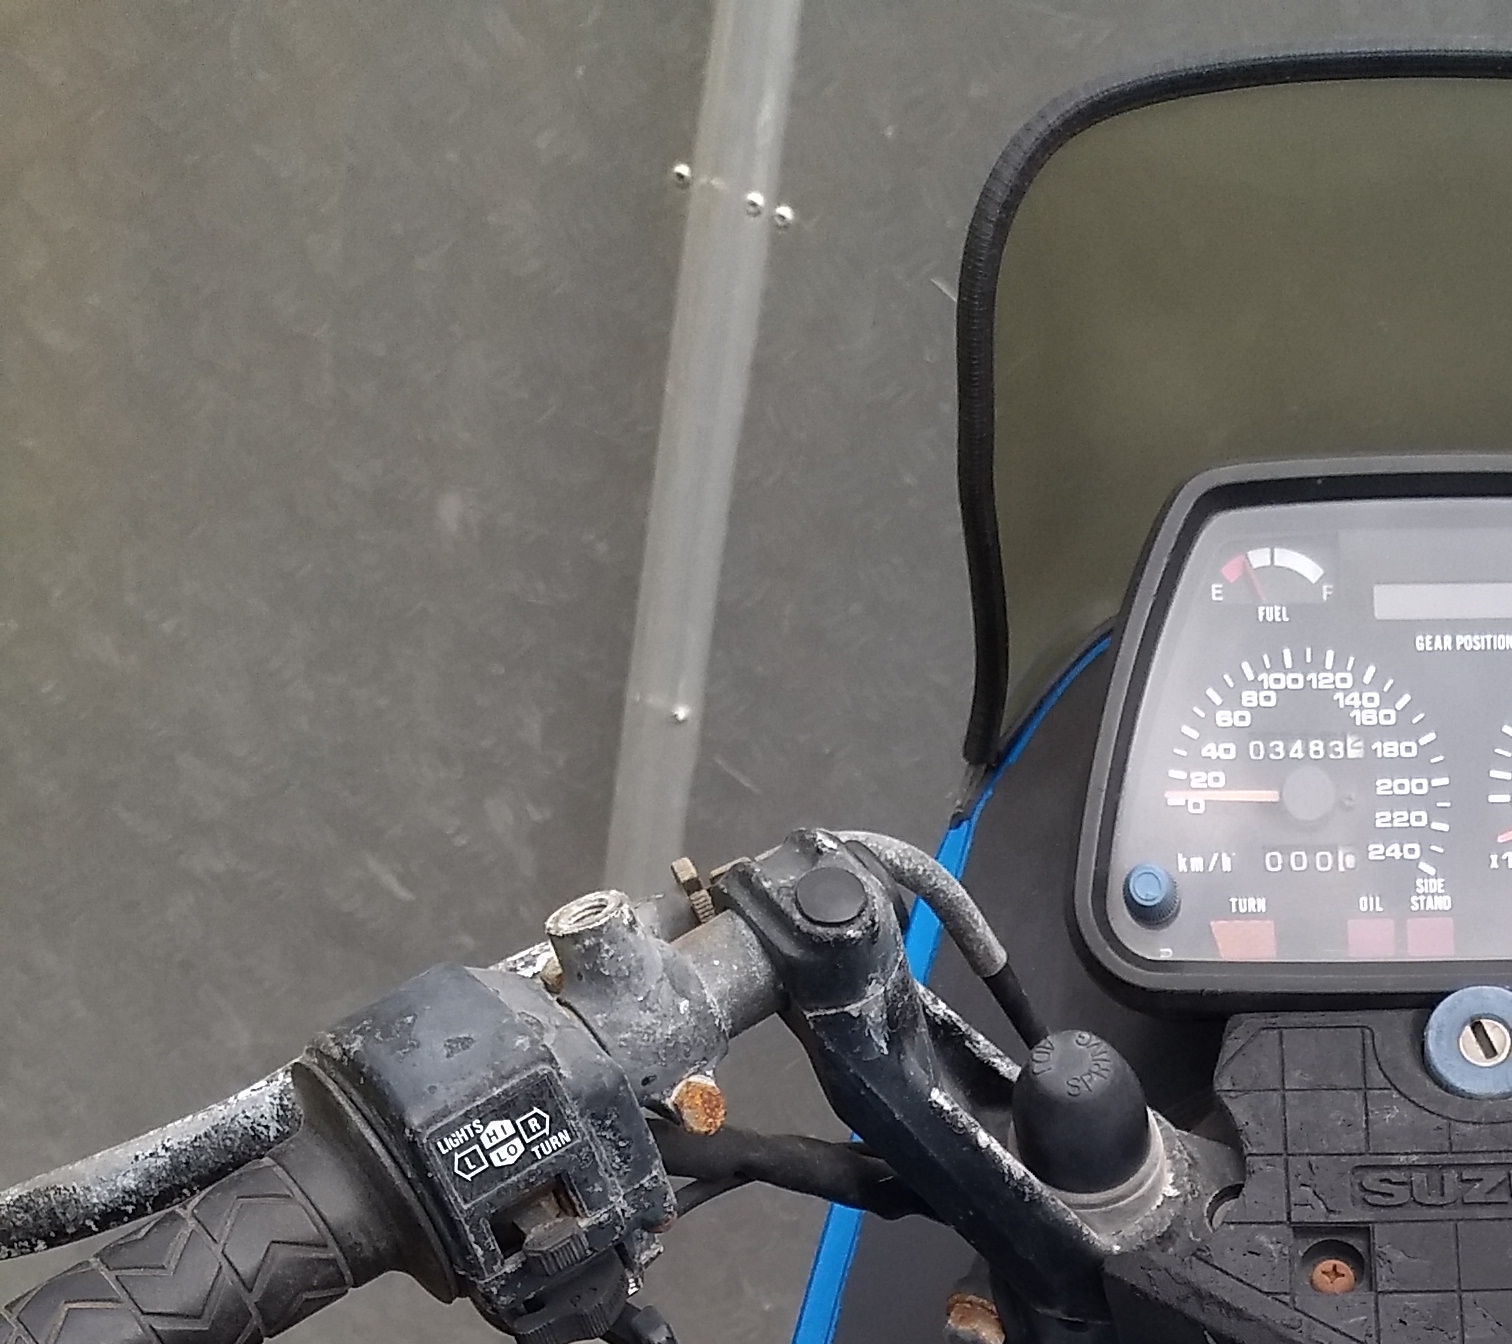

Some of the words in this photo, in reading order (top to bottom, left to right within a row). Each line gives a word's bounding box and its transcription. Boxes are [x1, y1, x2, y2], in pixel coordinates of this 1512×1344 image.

[1211, 584, 1223, 601] E
[1258, 606, 1291, 622] FUEL
[1415, 635, 1452, 651] GEAR
[1257, 673, 1304, 690] 100
[1306, 672, 1353, 689] 120
[1241, 690, 1277, 707] 80
[1333, 692, 1380, 708] 140
[1215, 710, 1251, 727] 60
[1350, 709, 1397, 726] 160
[1201, 742, 1237, 760] 40
[1371, 741, 1418, 758] 180
[1190, 771, 1226, 788] 20
[1375, 778, 1428, 795] 200
[1187, 799, 1206, 814] 0
[1375, 811, 1428, 828] 220
[1368, 843, 1421, 860] 240
[1177, 853, 1232, 872] km/h
[1416, 879, 1445, 894] SIDE
[1229, 898, 1266, 913] TURN
[1359, 897, 1384, 912] OIL
[1410, 896, 1452, 911] STAND
[485, 1123, 509, 1145] HI
[527, 1118, 542, 1133] R
[436, 1119, 484, 1155] LIGHTS
[531, 1129, 572, 1160] TURN
[495, 1144, 519, 1162] LO
[463, 1157, 476, 1170] L
